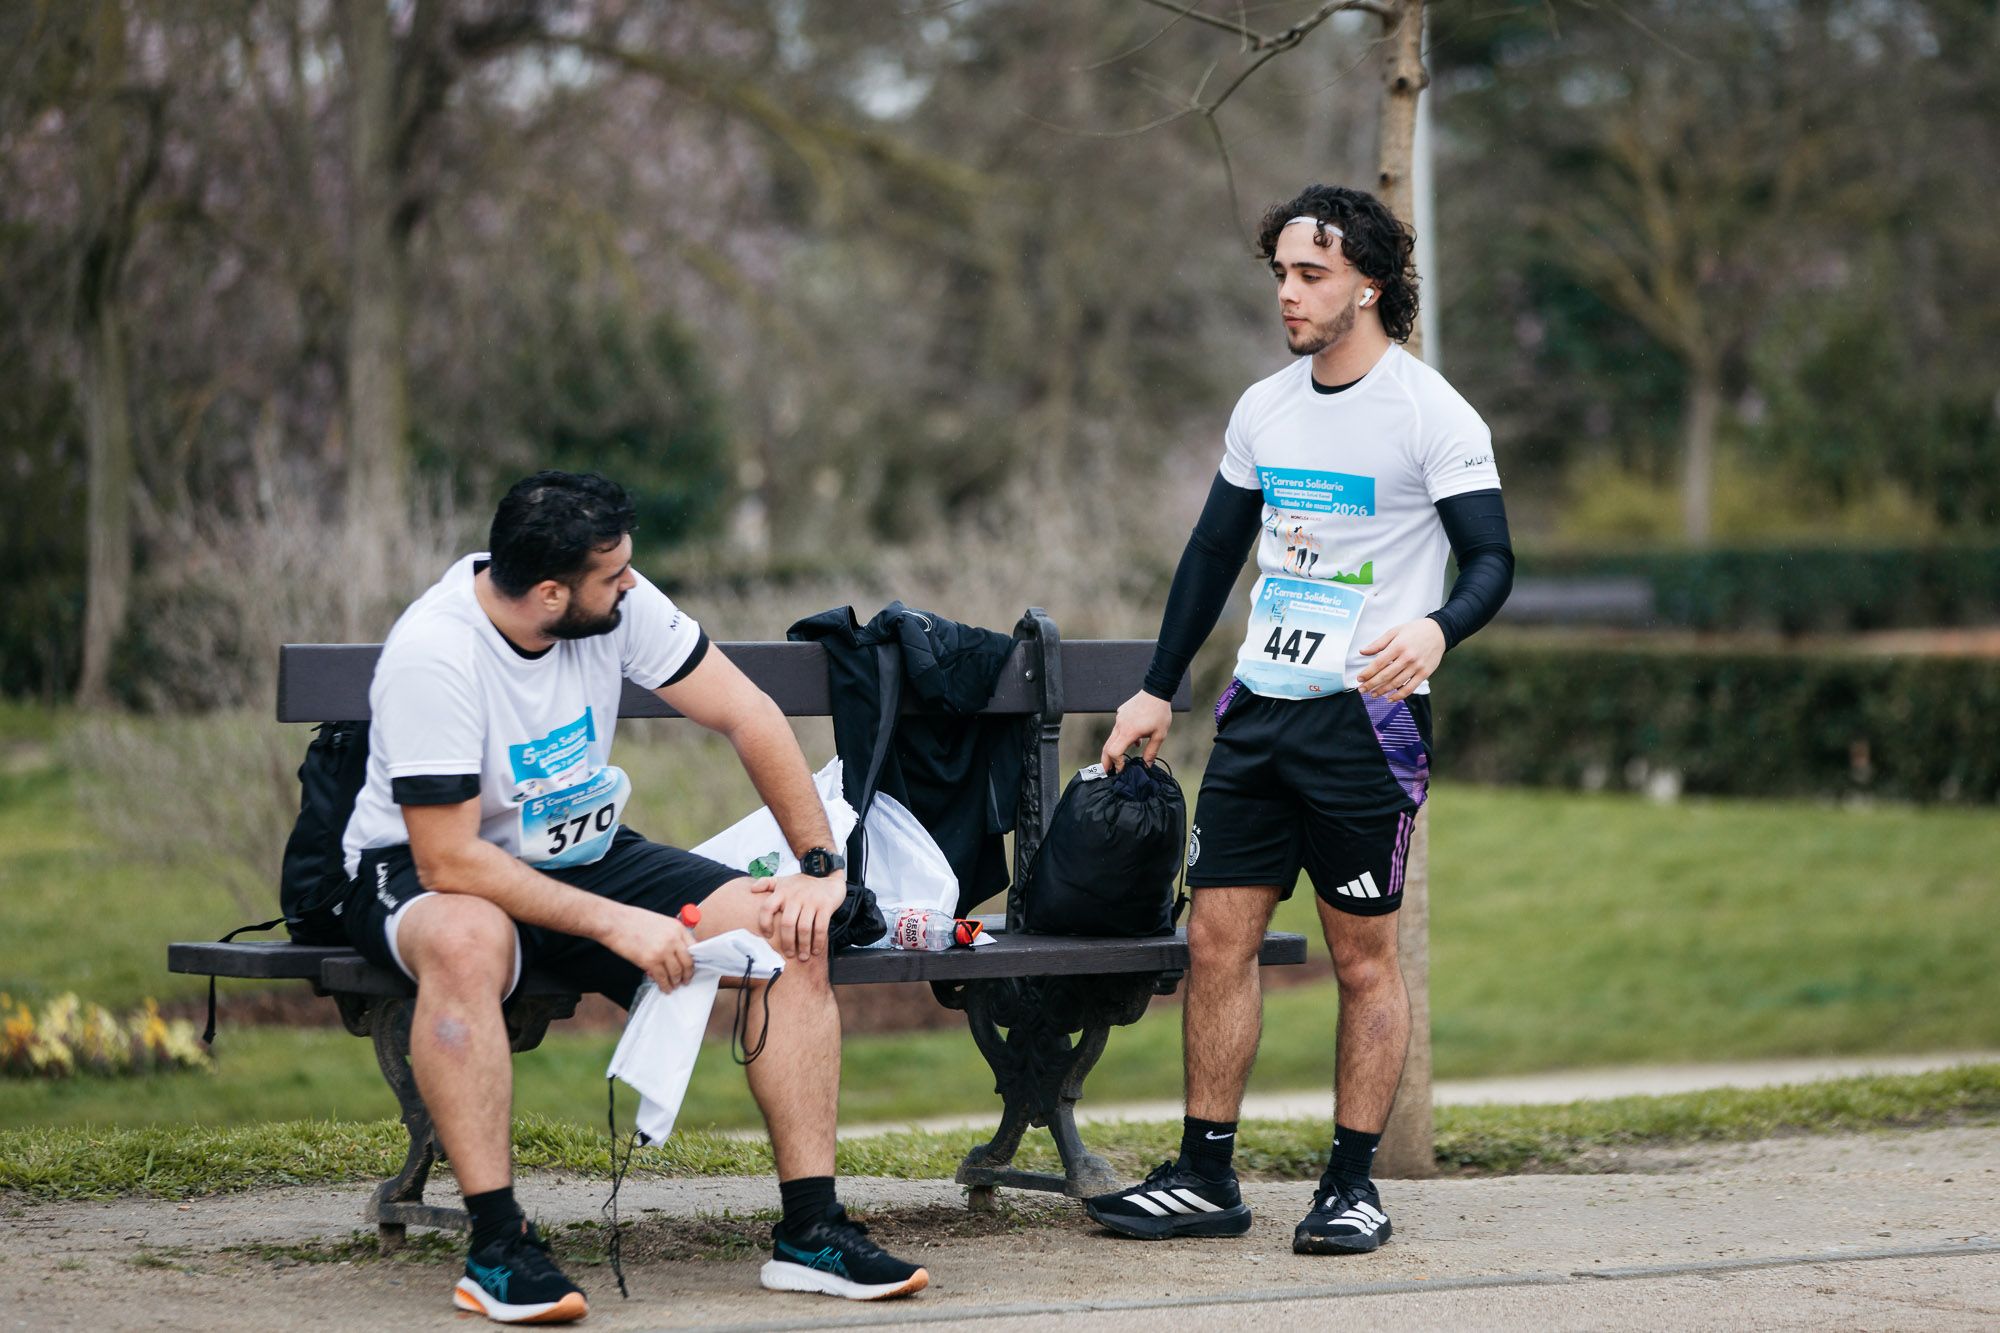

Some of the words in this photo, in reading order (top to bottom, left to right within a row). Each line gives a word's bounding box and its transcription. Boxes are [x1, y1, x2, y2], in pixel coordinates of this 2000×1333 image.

[1272, 476, 1304, 488] Carrera
[1306, 478, 1344, 492] Solidaria
[1332, 502, 1368, 516] 2026
[1274, 586, 1303, 600] Carrera
[1304, 591, 1342, 606] Solidaria
[1264, 626, 1326, 665] 447
[1308, 684, 1322, 692] CSL
[547, 802, 615, 855] 370
[905, 917, 913, 942] SODIO
[910, 918, 919, 942] ZERO
